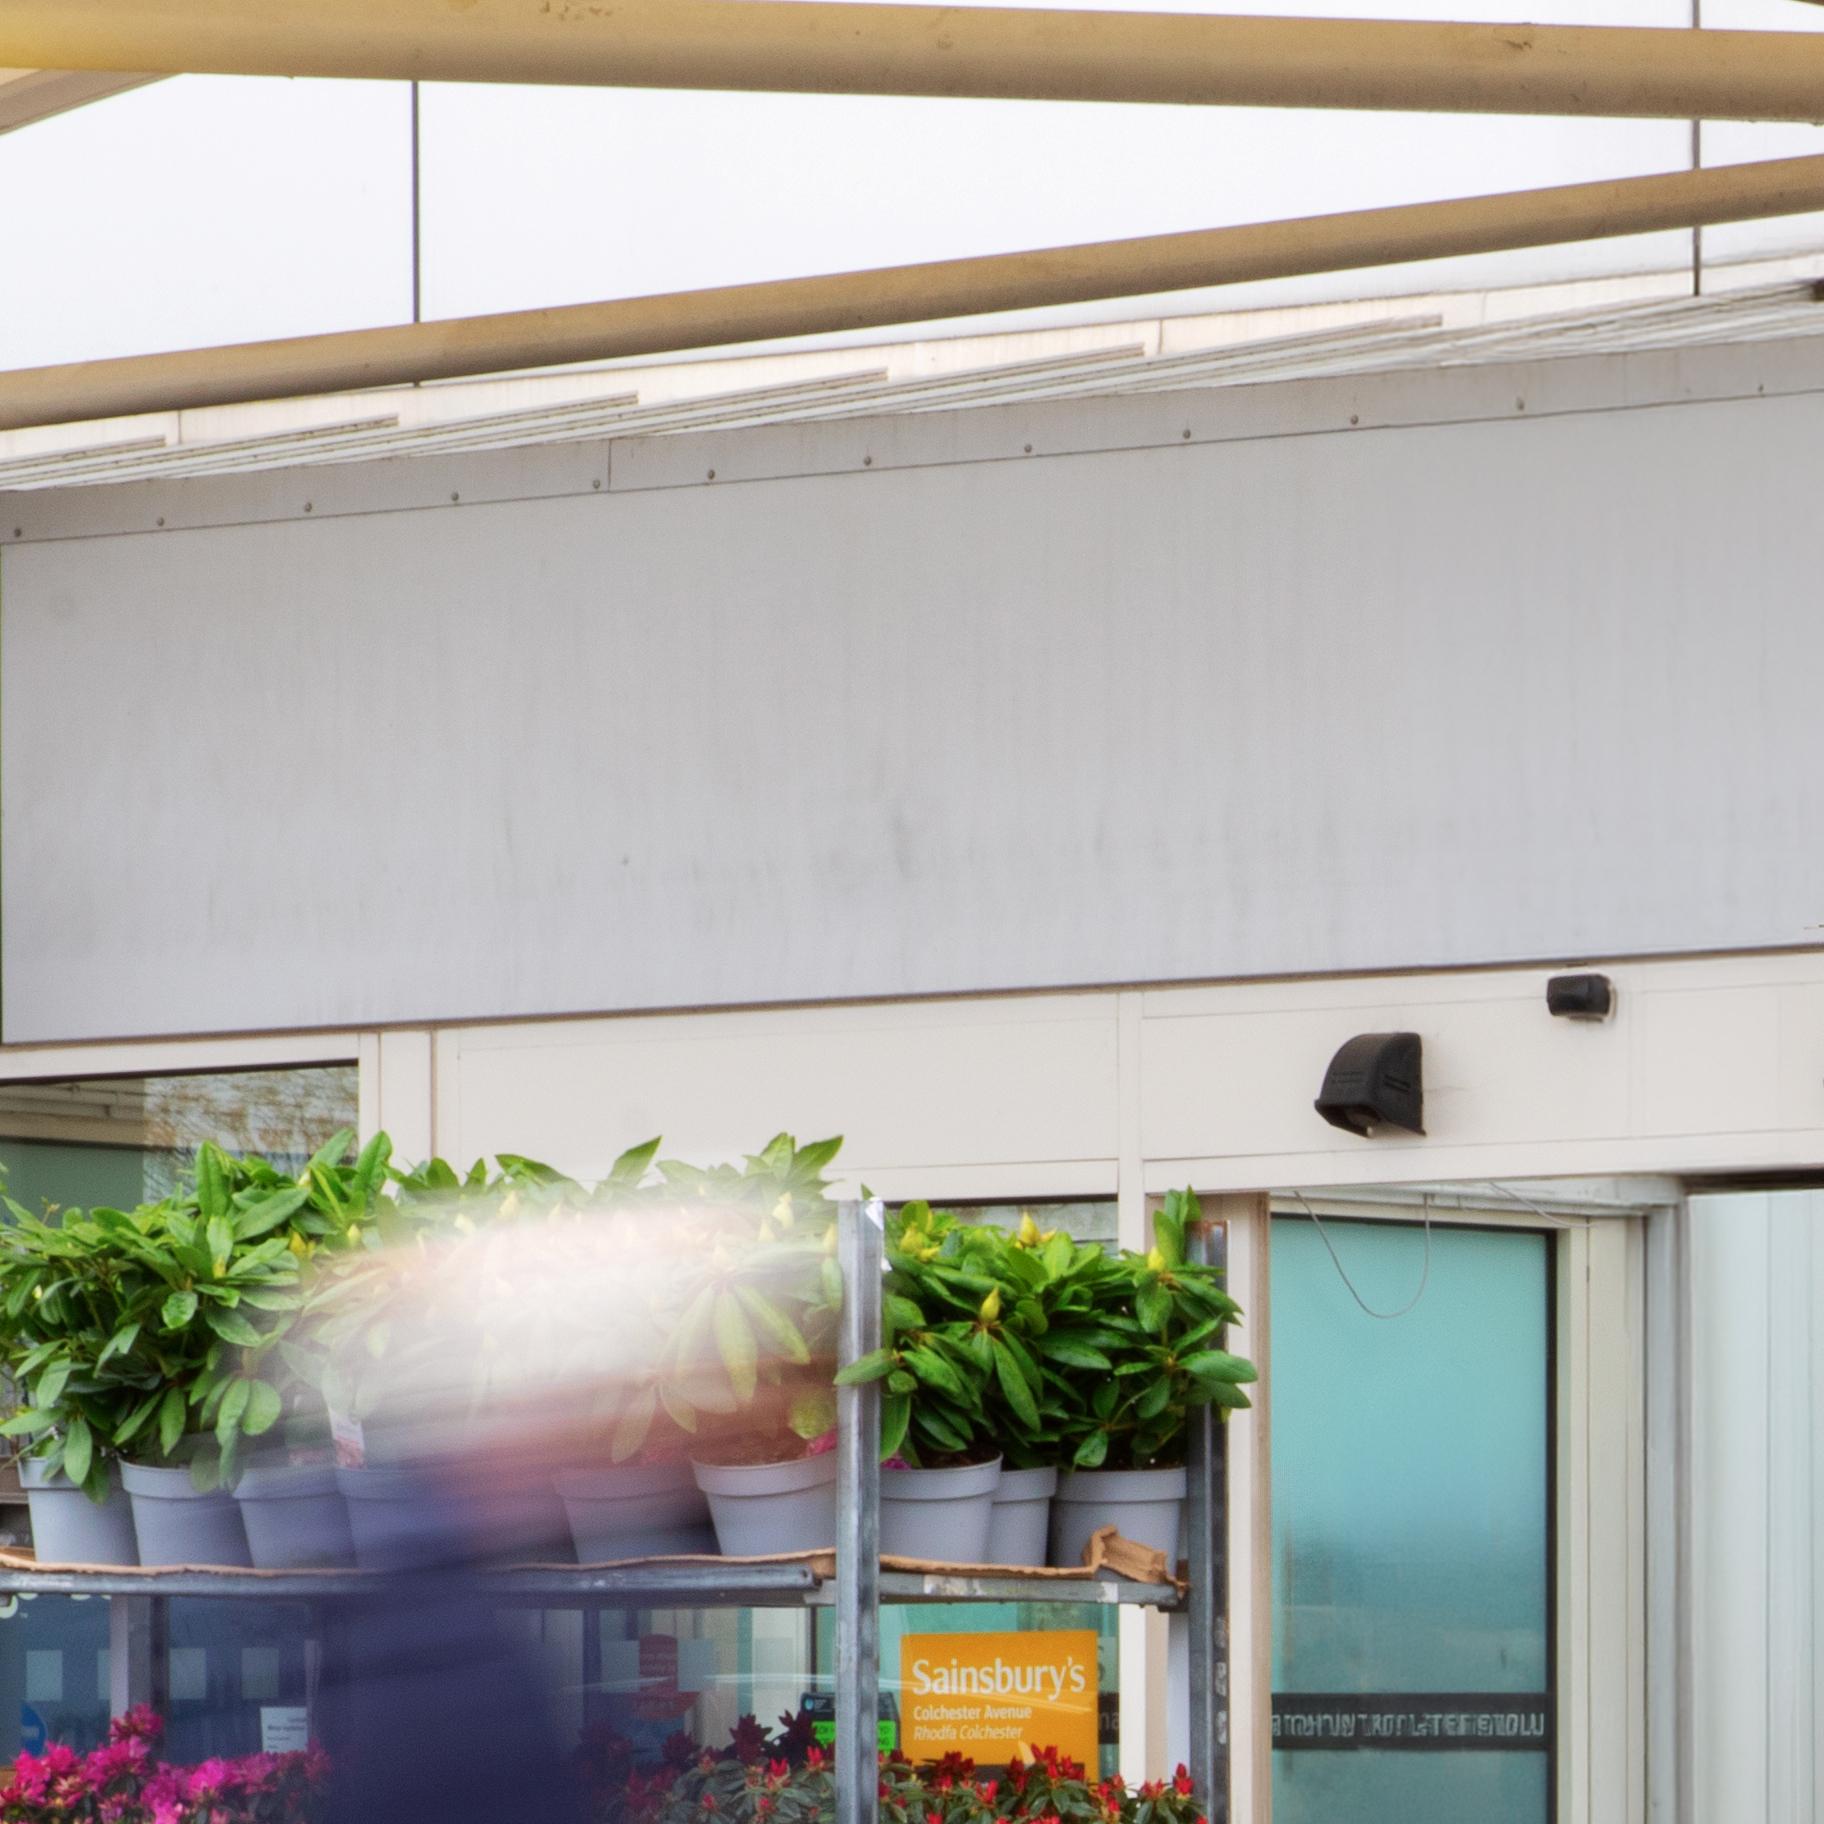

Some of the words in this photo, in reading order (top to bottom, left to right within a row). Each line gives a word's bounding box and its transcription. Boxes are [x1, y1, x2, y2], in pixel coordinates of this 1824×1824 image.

[912, 1656, 1085, 1700] Sainsbury's
[913, 1704, 980, 1720] Colchester
[984, 1704, 1032, 1720] Avenue
[913, 1725, 957, 1741] Rhodfa
[959, 1724, 1023, 1740] Colchester
